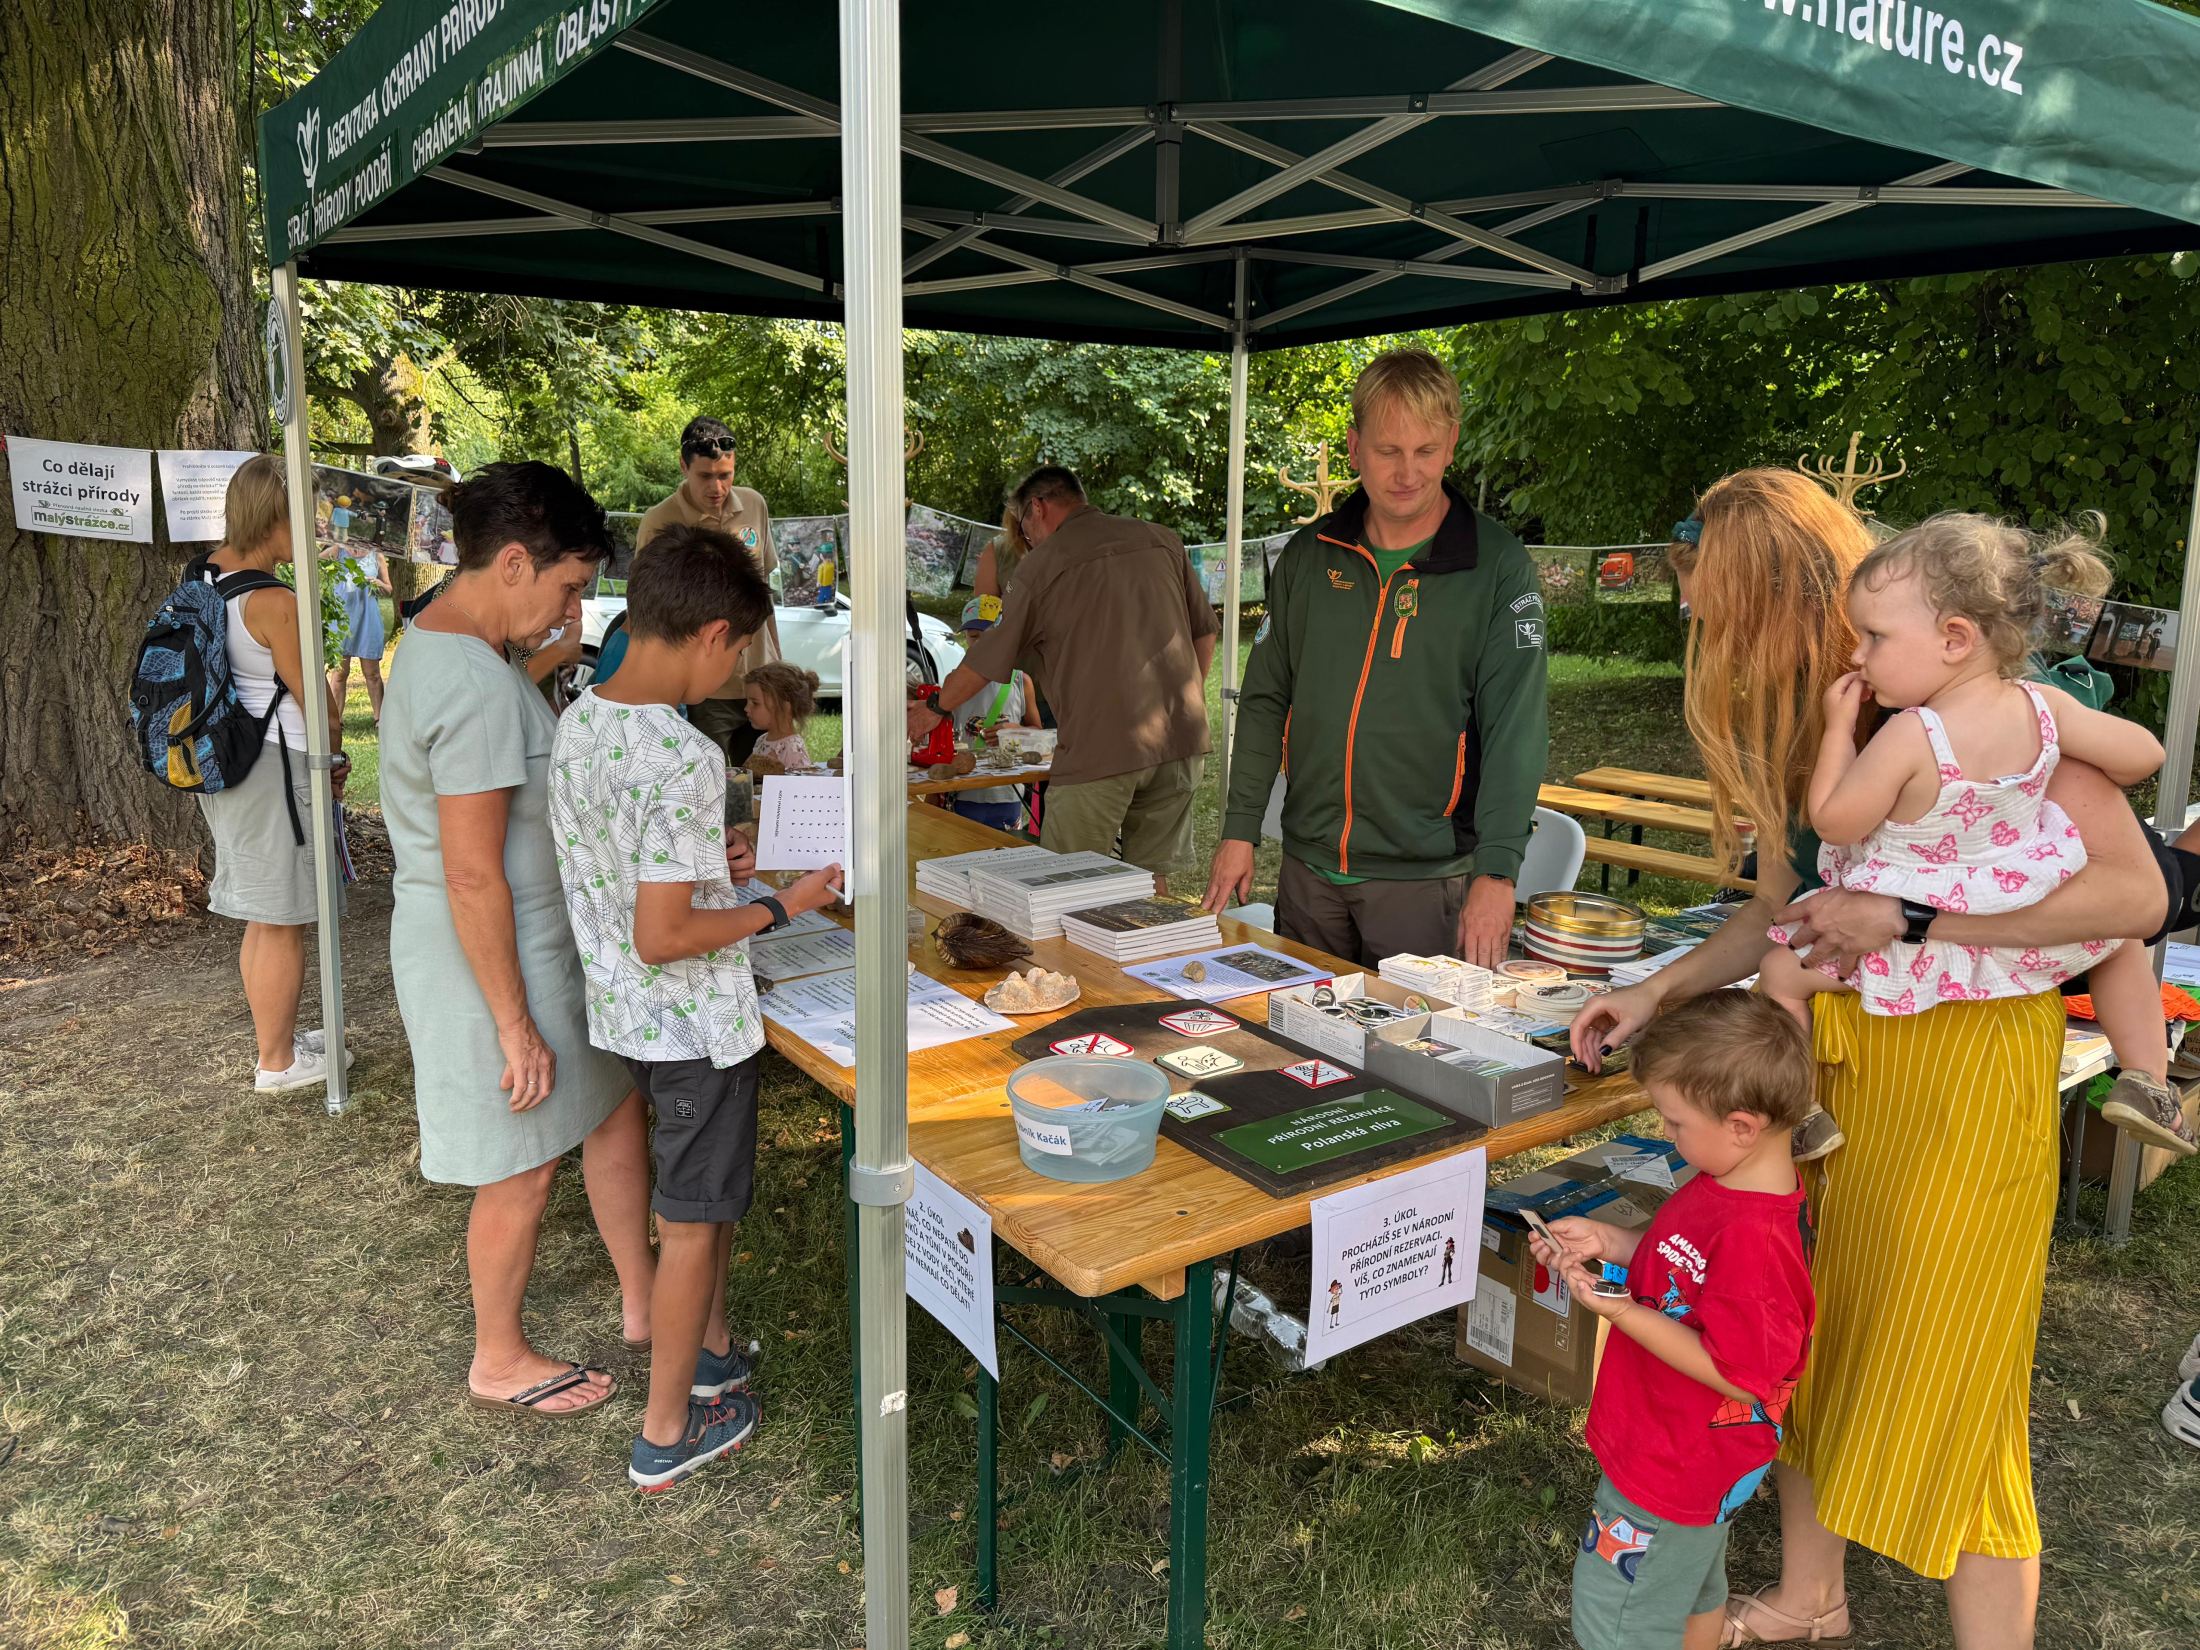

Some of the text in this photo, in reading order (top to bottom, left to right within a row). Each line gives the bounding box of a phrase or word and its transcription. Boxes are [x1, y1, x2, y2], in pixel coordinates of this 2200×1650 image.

[327, 88, 379, 163] AGENTURA
[381, 25, 437, 117] OCHRANY
[412, 84, 471, 174] CHRÁNĚNÁ
[477, 31, 544, 124] KRAJINNÁ
[287, 136, 392, 250] STRÁŽ PŘÍRODY POODŘÍ
[42, 459, 115, 480] Co dělají
[22, 480, 140, 505] strážci přírody
[33, 510, 130, 531] malýstrážce.cz
[1267, 1105, 1396, 1145] PŘÍRODNÍ REZERVACE
[1290, 1106, 1348, 1126] NÁRODNÍ
[1036, 1131, 1067, 1146] Kačák
[1301, 1126, 1369, 1151] Polanská
[919, 1201, 945, 1228] 2. ÚKOL
[1383, 1207, 1418, 1228] 3. ÚKOL
[921, 1218, 931, 1231] CO
[932, 1225, 959, 1256] NEPATŘÍ
[959, 1251, 969, 1265] DO
[1341, 1208, 1455, 1261] PROCHÁZÍŠ SE V NÁRODNÍ
[1350, 1230, 1443, 1273] PŘÍRODNÍ REZERVACI.
[915, 1256, 940, 1282] NEMAJÍ
[940, 1276, 949, 1290] CO
[916, 1242, 921, 1252] Z
[921, 1246, 940, 1267] VODY
[940, 1259, 957, 1284] VĚCI,
[957, 1277, 975, 1302] KTERÉ
[919, 1231, 925, 1242] A
[925, 1234, 941, 1255] TŮNÍ
[941, 1248, 947, 1259] V
[947, 1252, 974, 1286] POODŘÍ?
[1354, 1244, 1438, 1288] VÍŠ, CO ZNAMENAJÍ
[1359, 1265, 1429, 1301] TYTO SYMBOLY?
